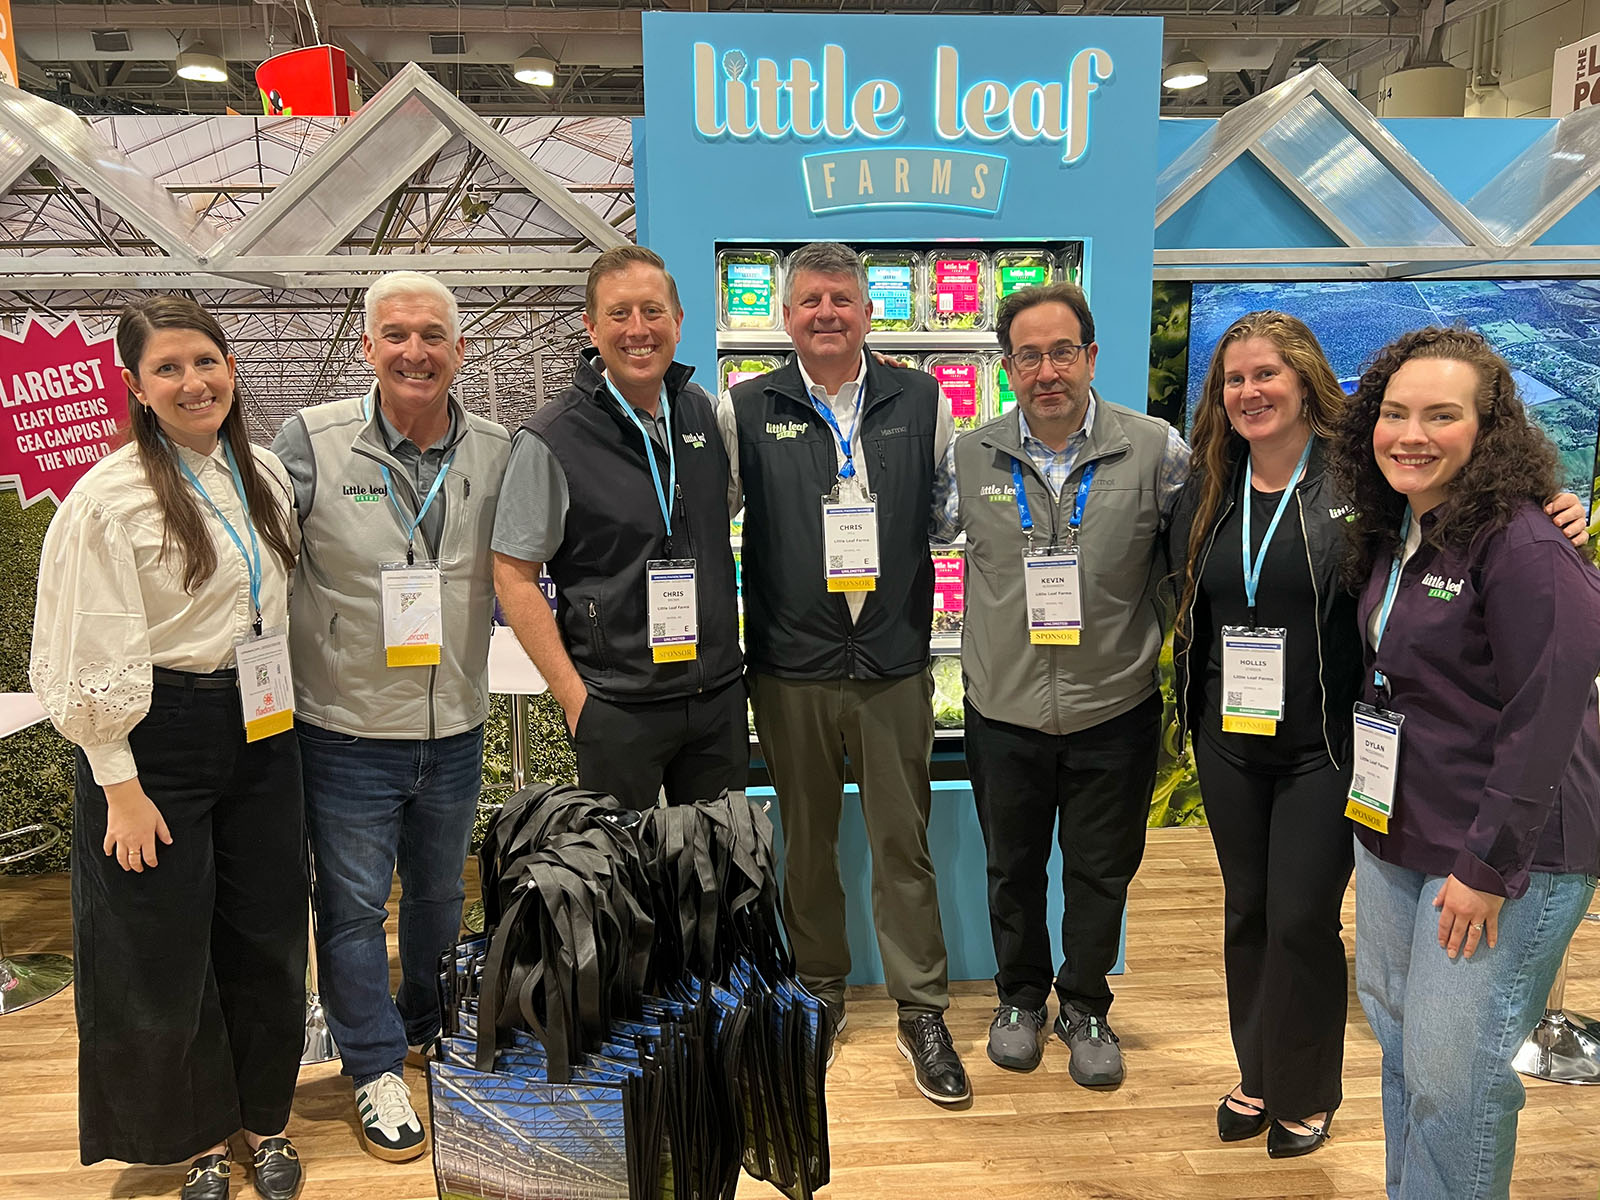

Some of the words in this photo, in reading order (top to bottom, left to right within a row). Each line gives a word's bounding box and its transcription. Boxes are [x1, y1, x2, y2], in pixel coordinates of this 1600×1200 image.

[1576, 48, 1587, 81] THE
[694, 42, 905, 138] little
[936, 46, 1114, 162] leaf
[822, 157, 989, 200] FARMS
[0, 359, 105, 409] LARGEST
[13, 408, 54, 431] LEAFY
[55, 398, 109, 424] GREENS
[16, 432, 45, 454] CEA
[45, 421, 102, 449] CAMPUS
[103, 418, 118, 437] IN
[766, 421, 787, 434] little
[788, 421, 809, 434] leaf
[35, 452, 64, 472] THE
[62, 442, 111, 467] WORLD
[343, 484, 367, 496] little
[1421, 573, 1445, 589] little
[1446, 578, 1465, 595] leaf
[1035, 632, 1073, 640] SPONSOR
[659, 649, 692, 657] SPONSOR
[1240, 659, 1267, 667] HOLLIS
[1365, 739, 1385, 753] DYLAN
[1351, 807, 1382, 826] SPONSOR
